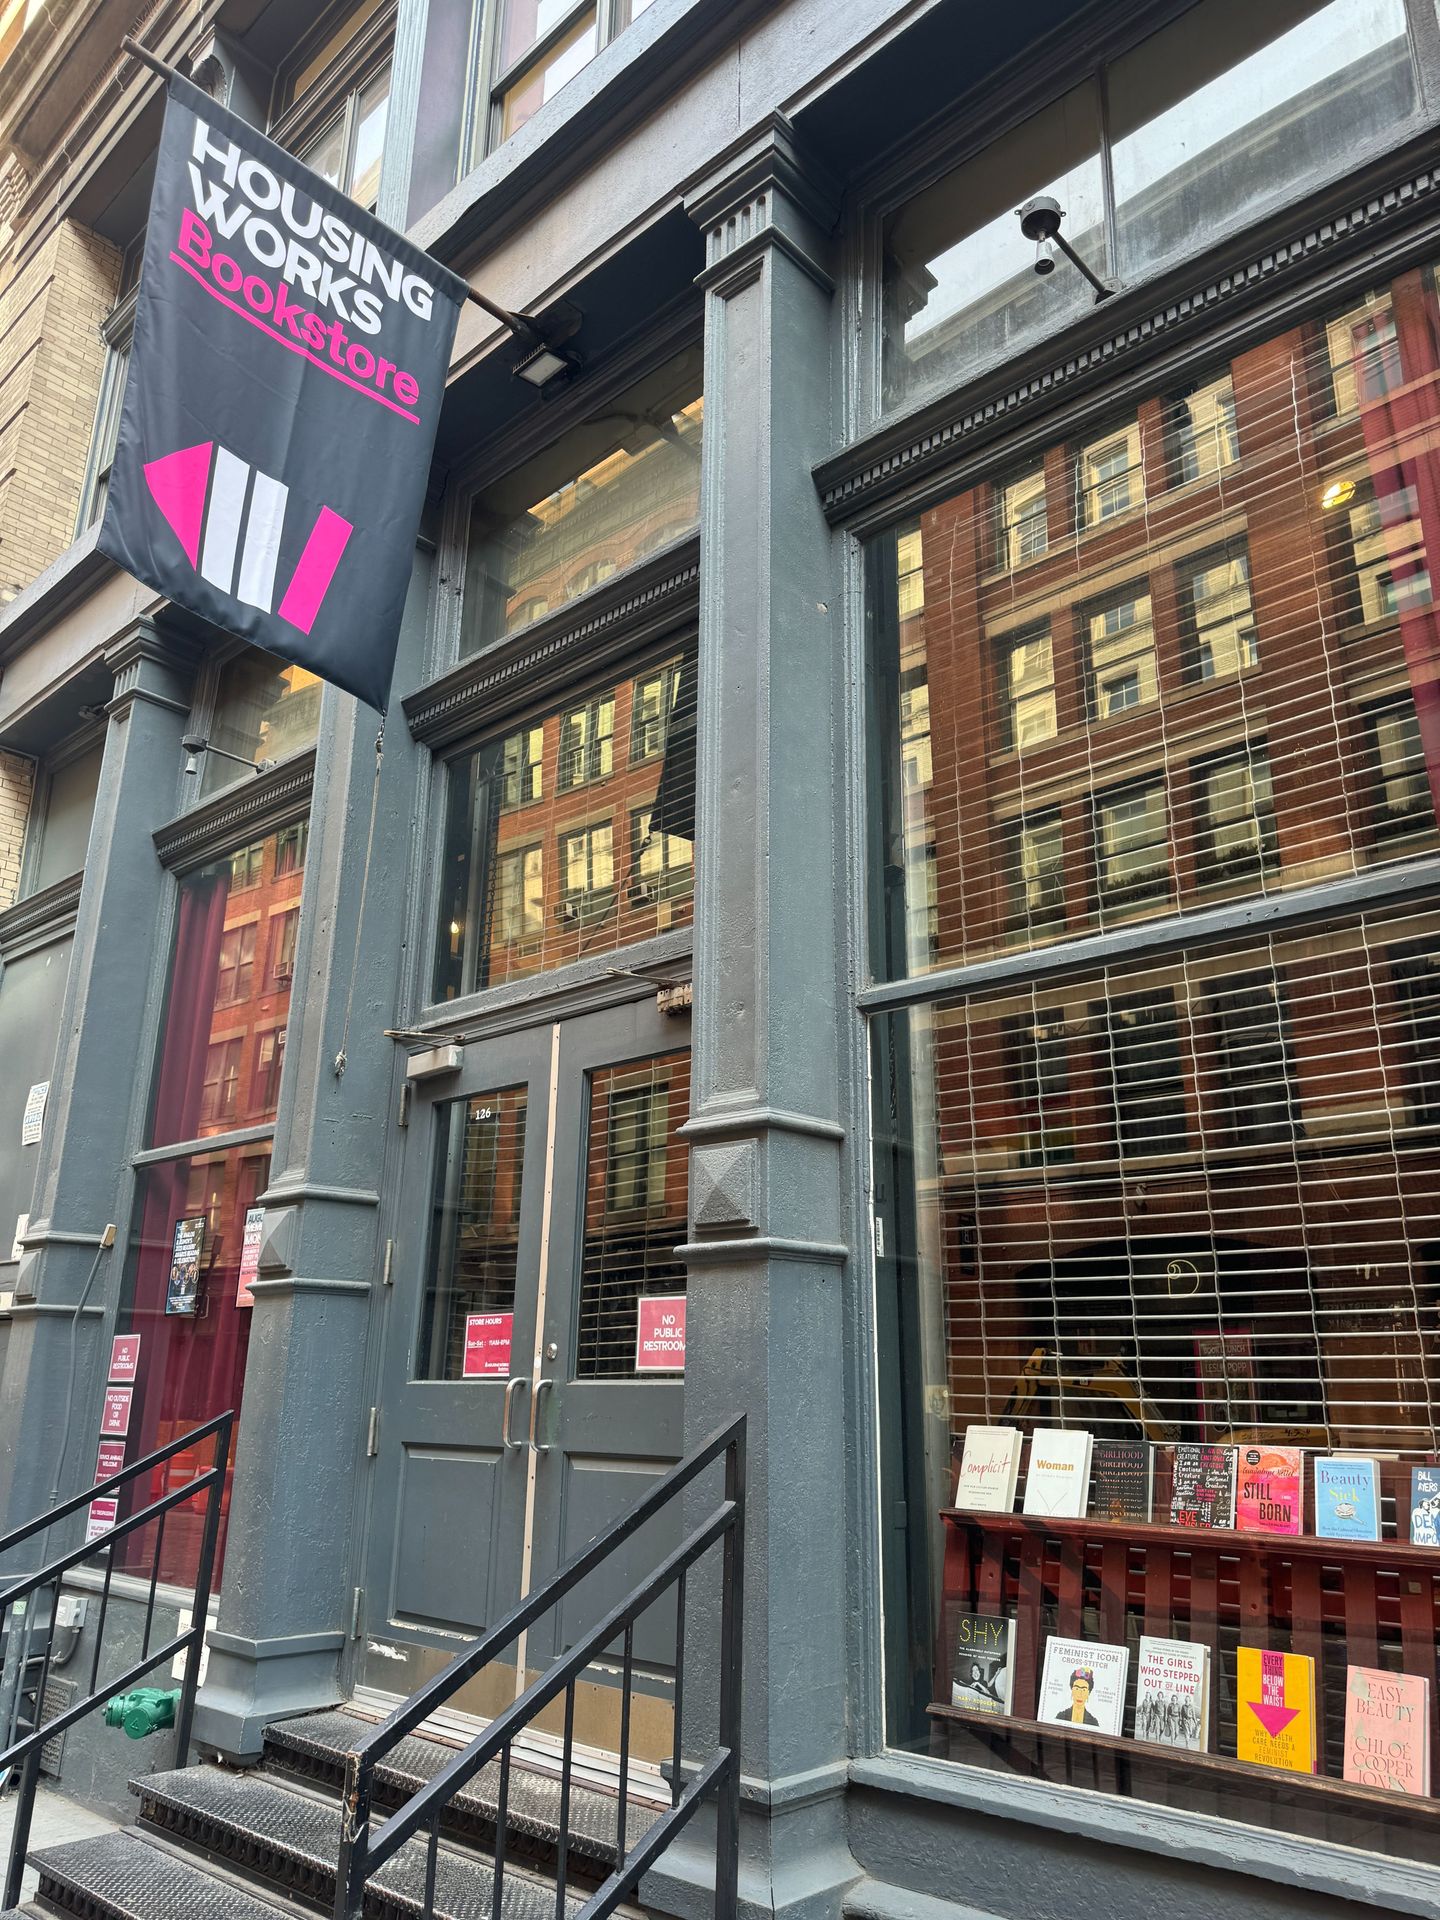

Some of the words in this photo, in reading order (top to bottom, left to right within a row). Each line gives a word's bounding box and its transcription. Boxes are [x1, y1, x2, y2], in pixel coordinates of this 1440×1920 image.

[192, 118, 435, 321] HOUSING
[187, 161, 383, 334] WORKS
[177, 207, 420, 405] Bookstore
[475, 1107, 490, 1120] 126
[662, 1315, 675, 1325] NO
[654, 1328, 683, 1338] PUBLIC
[1228, 1363, 1247, 1372] POPP
[1100, 1450, 1143, 1459] GIRLHOOD
[960, 1450, 1010, 1483] Complicit
[1037, 1460, 1074, 1471] Woman
[1321, 1470, 1370, 1491] Beauty
[1418, 1471, 1432, 1481] BILL
[1244, 1482, 1272, 1500] STILL
[1418, 1482, 1438, 1492] AYERS
[1179, 1511, 1197, 1521] EVE
[1260, 1503, 1291, 1522] BORN
[960, 1619, 1004, 1646] SHY
[1053, 1647, 1094, 1659] FEMINIST
[1097, 1654, 1119, 1662] ICON
[1264, 1655, 1283, 1665] EVERY
[1062, 1656, 1108, 1669] CROSS-STITCH
[1148, 1654, 1164, 1665] THE
[1167, 1658, 1193, 1669] GIRLS
[1141, 1665, 1161, 1676] WHO
[1163, 1669, 1200, 1683] STEPPED
[1264, 1665, 1282, 1675] THING
[1144, 1678, 1162, 1688] OUT
[1175, 1684, 1195, 1695] LINE
[1263, 1675, 1283, 1687] BELOW
[1268, 1685, 1279, 1696] THE
[1368, 1682, 1404, 1703] EASY
[1263, 1695, 1283, 1707] WAIST
[1356, 1698, 1414, 1722] BEAUTY
[1255, 1729, 1267, 1738] WHY
[1253, 1737, 1267, 1746] CARE
[1270, 1739, 1289, 1751] NEEDS
[1356, 1736, 1412, 1760] CHLOÉ
[1260, 1746, 1288, 1757] FEMINIST
[1254, 1754, 1293, 1767] REVOLUTION
[1353, 1752, 1414, 1778] COOPER
